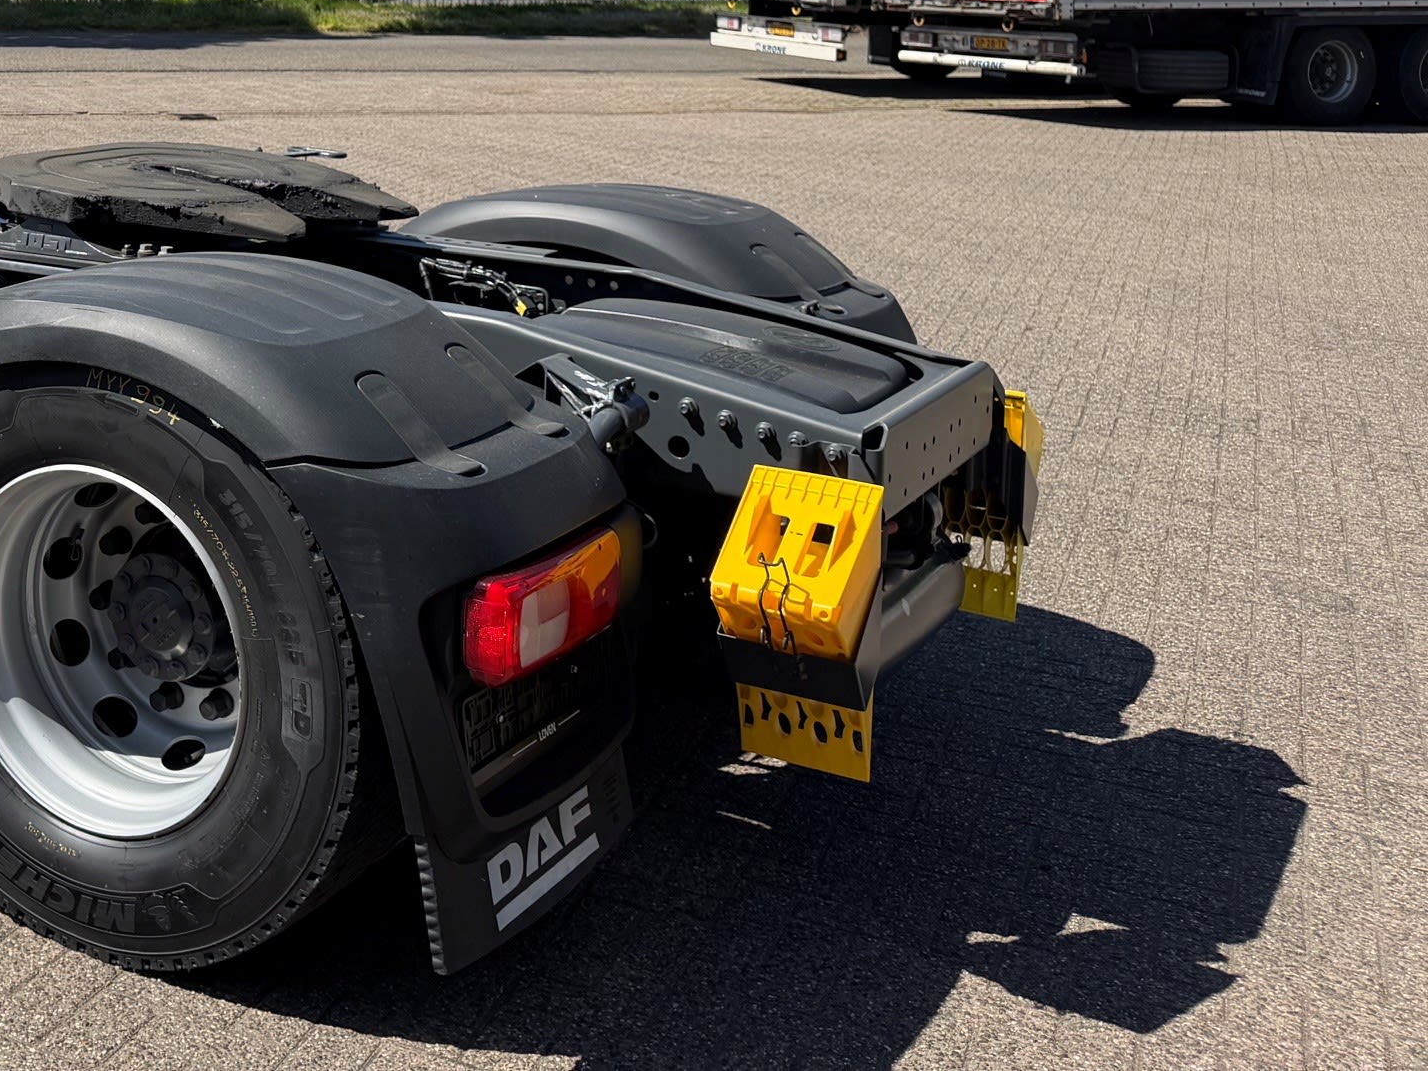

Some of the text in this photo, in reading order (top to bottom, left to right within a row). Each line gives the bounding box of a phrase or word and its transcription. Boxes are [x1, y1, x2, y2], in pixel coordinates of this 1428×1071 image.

[762, 44, 786, 55] KRONE
[968, 59, 1006, 70] KRONE
[538, 721, 557, 742] LOVEN
[486, 784, 592, 906] DAF
